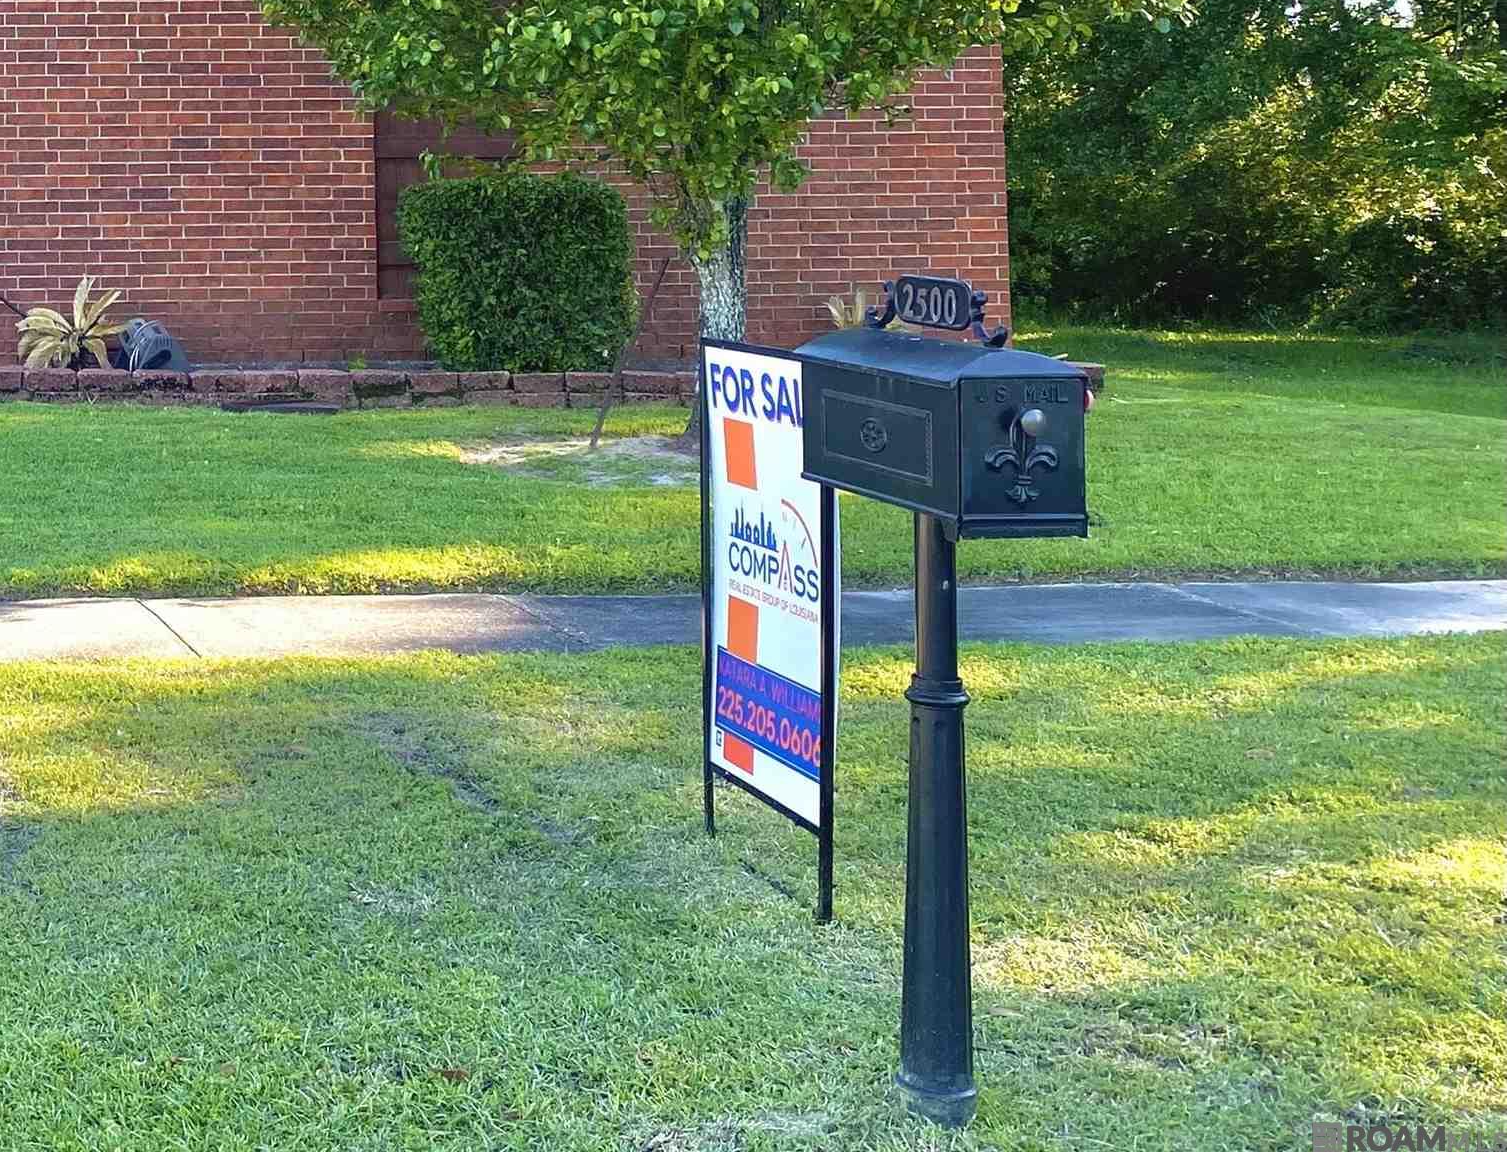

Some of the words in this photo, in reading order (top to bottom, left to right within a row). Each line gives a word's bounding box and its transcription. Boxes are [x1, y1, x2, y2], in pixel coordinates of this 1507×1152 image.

[902, 283, 957, 325] 2500
[710, 363, 758, 419] FOR
[761, 373, 803, 428] SAL
[1024, 384, 1069, 403] MAIL
[728, 539, 820, 603] COMPASS
[717, 686, 820, 767] 225.205.0606
